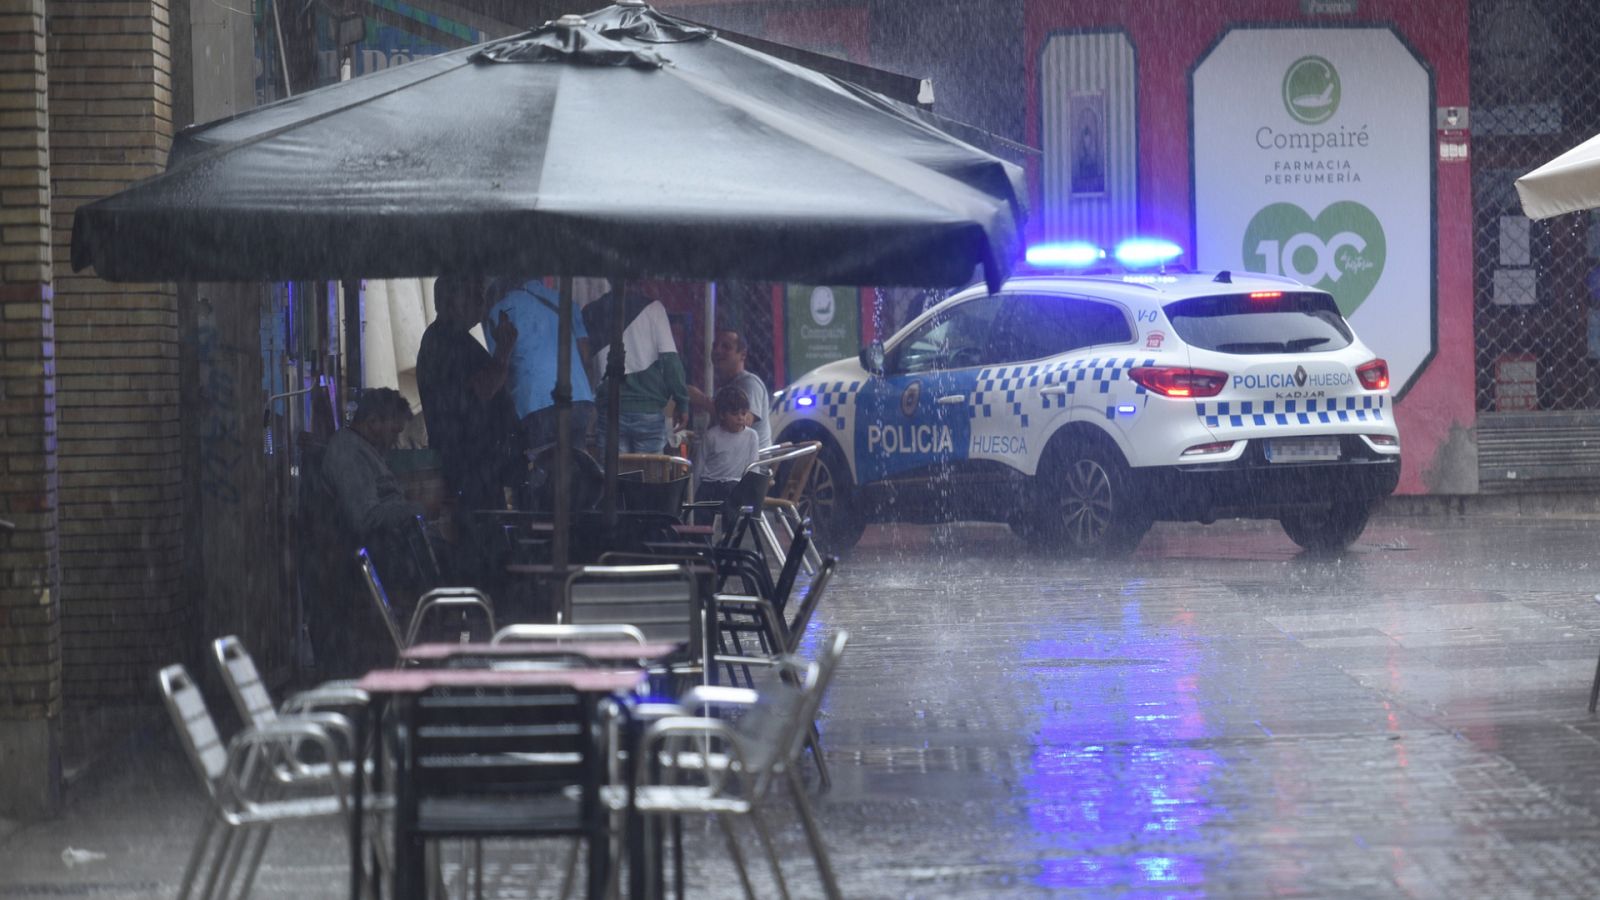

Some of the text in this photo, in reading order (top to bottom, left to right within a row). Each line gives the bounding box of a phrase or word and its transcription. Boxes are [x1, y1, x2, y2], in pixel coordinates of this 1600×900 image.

[1255, 124, 1369, 153] Compairé
[1274, 160, 1351, 171] FARMACIA
[1264, 171, 1361, 185] PERFUMERÍA
[1233, 372, 1353, 389] POLICIA HUESCA
[1276, 390, 1325, 399] KADJAR
[867, 424, 1028, 455] POLICIA HUESCA
